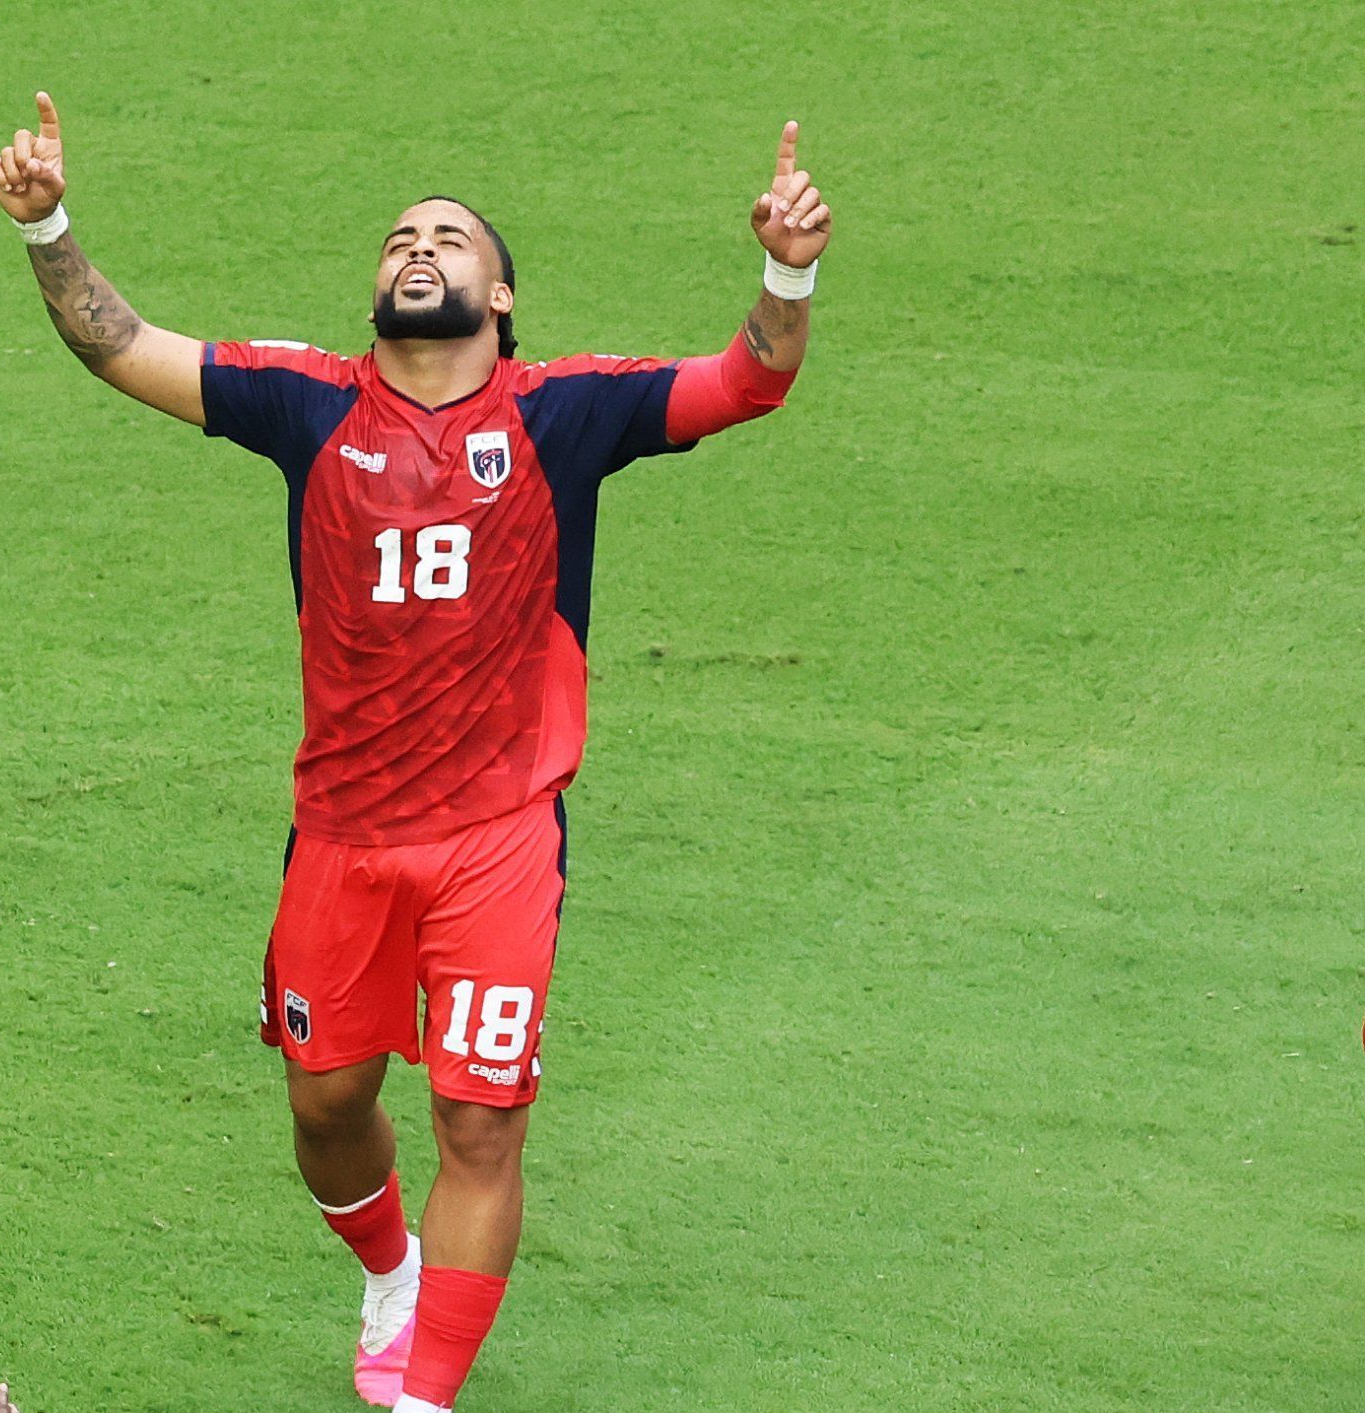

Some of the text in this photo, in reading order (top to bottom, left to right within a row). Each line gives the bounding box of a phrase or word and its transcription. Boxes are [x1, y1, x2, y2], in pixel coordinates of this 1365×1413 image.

[372, 524, 472, 603] 18
[442, 979, 534, 1060] 18
[468, 1064, 521, 1082] capelli
